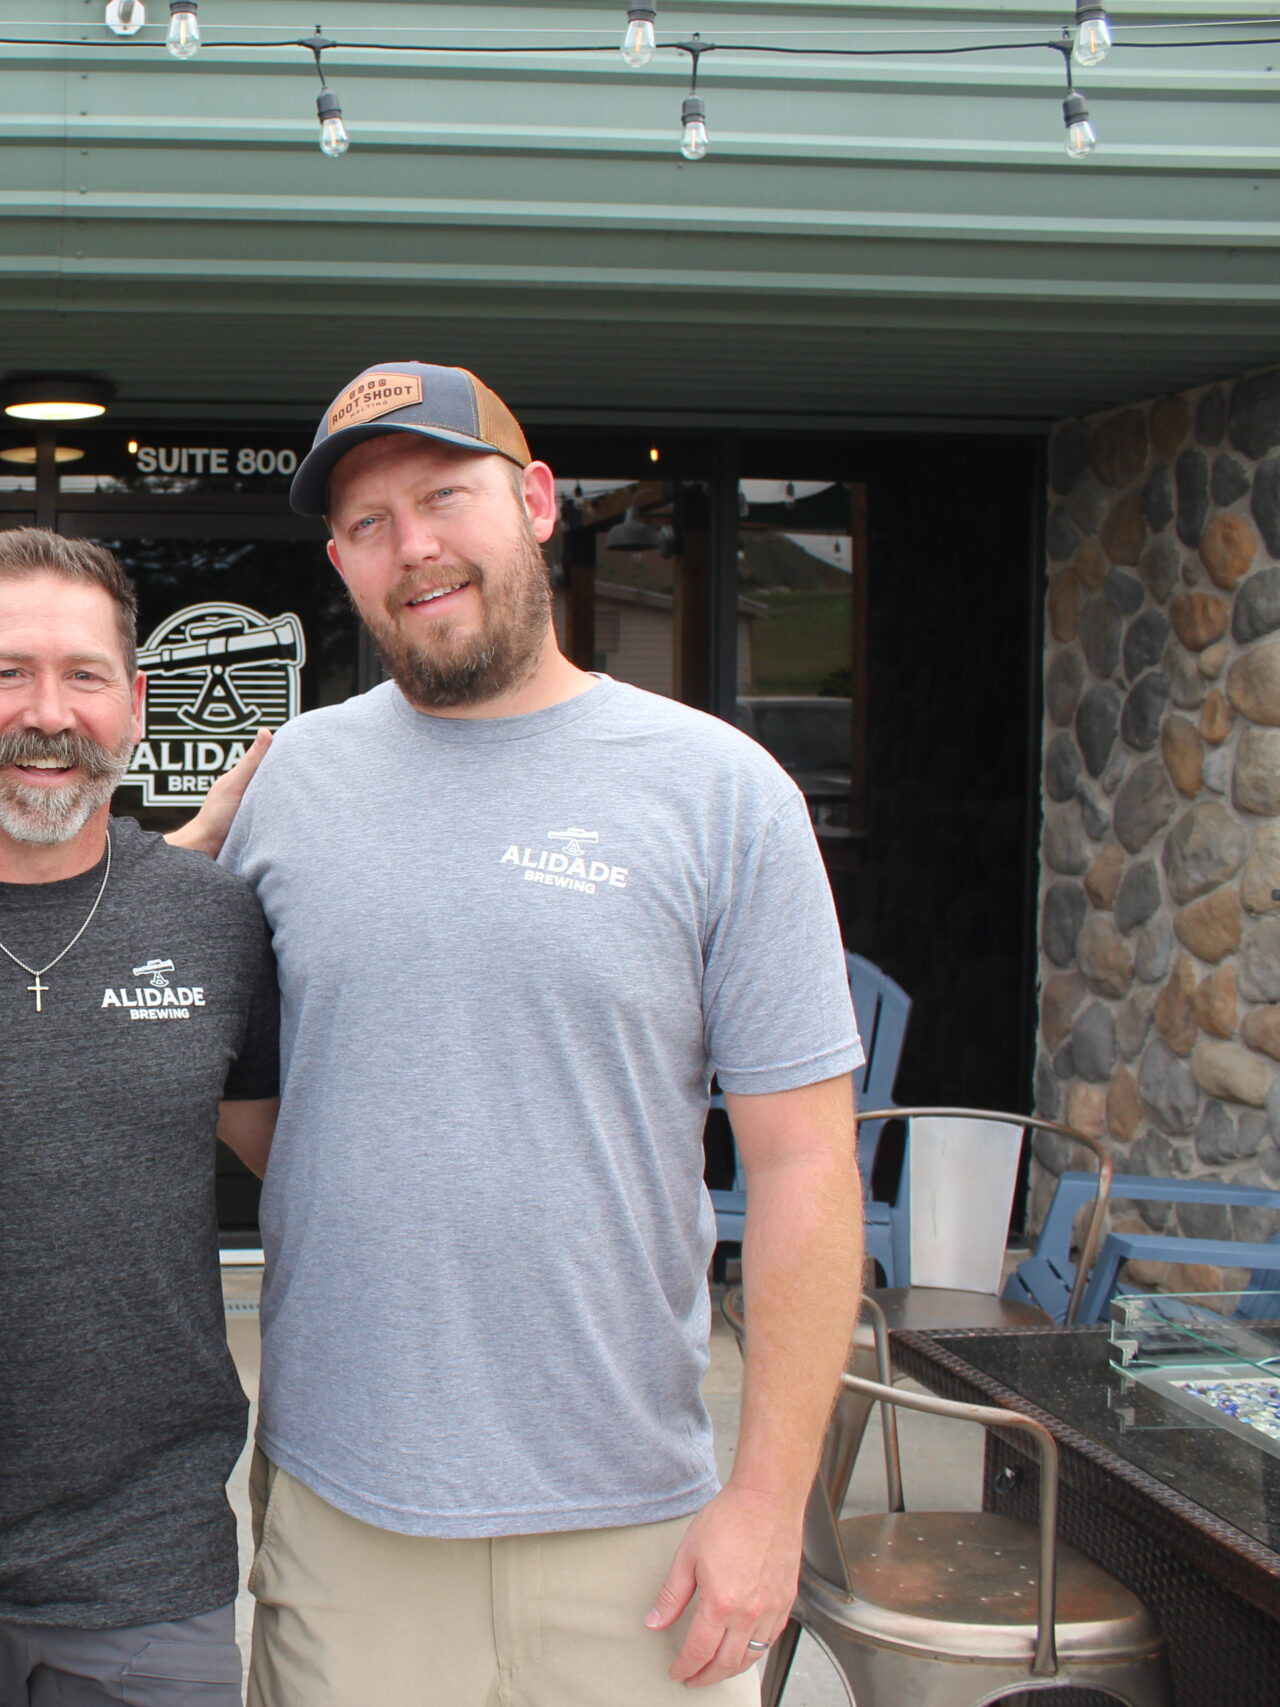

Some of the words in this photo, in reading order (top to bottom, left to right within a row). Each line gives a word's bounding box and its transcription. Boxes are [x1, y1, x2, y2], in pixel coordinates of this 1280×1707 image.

[332, 397, 360, 426] ROOT
[363, 386, 413, 403] SHOOT
[350, 400, 388, 418] MALTING
[136, 447, 229, 473] SUITE
[236, 448, 297, 475] 800
[130, 742, 246, 771] ALIDA
[500, 845, 629, 888] ALIDADE
[524, 870, 596, 895] BREWING
[101, 986, 206, 1008] ALIDADE
[129, 1008, 190, 1020] BREWING
